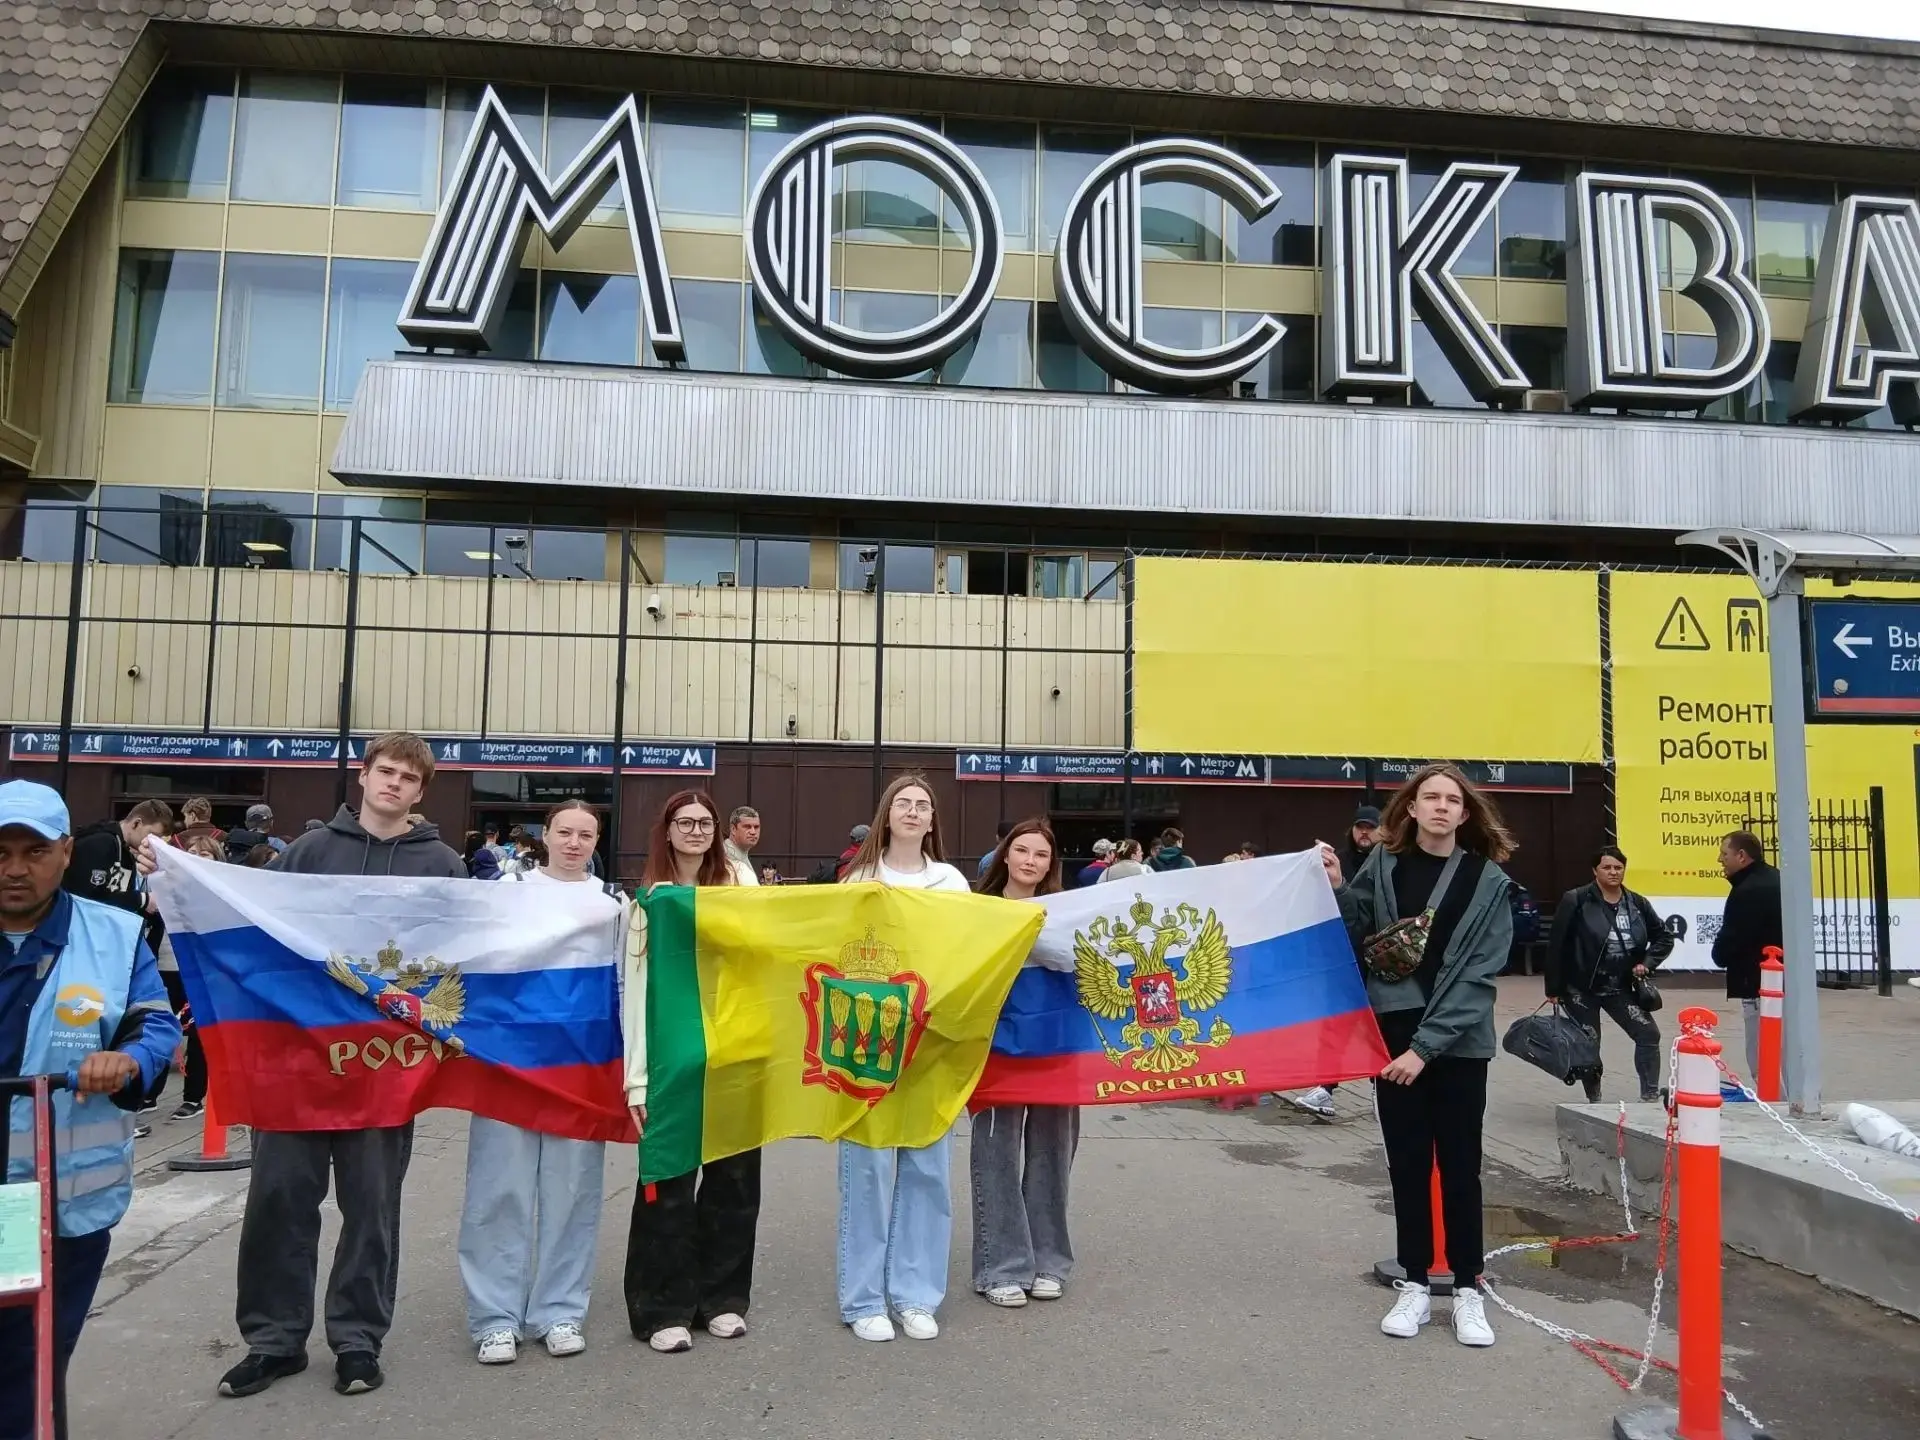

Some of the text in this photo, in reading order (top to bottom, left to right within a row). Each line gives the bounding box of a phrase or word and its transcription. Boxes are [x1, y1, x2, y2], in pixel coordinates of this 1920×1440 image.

[396, 84, 1920, 412] МОСКВА
[123, 735, 220, 748] Пункт досмотра
[291, 738, 332, 750] Метро
[122, 745, 168, 754] Inspection
[290, 748, 319, 757] Metro
[480, 743, 575, 756] Пункт досмотра
[642, 746, 680, 758] Метро
[1659, 731, 1768, 765] работы
[480, 753, 525, 762] Inspection
[642, 756, 669, 765] Metro
[1055, 756, 1139, 767] Пункт досмота
[1200, 757, 1235, 769] Метро
[1055, 765, 1095, 774] Inspection
[1200, 768, 1225, 776] Metro
[1382, 762, 1408, 773] Вход
[1659, 786, 1690, 804] Для
[1694, 790, 1750, 804] выхода
[1662, 831, 1725, 847] Извини
[1698, 869, 1727, 879] выхо
[1095, 1069, 1248, 1099] РОССИЯ
